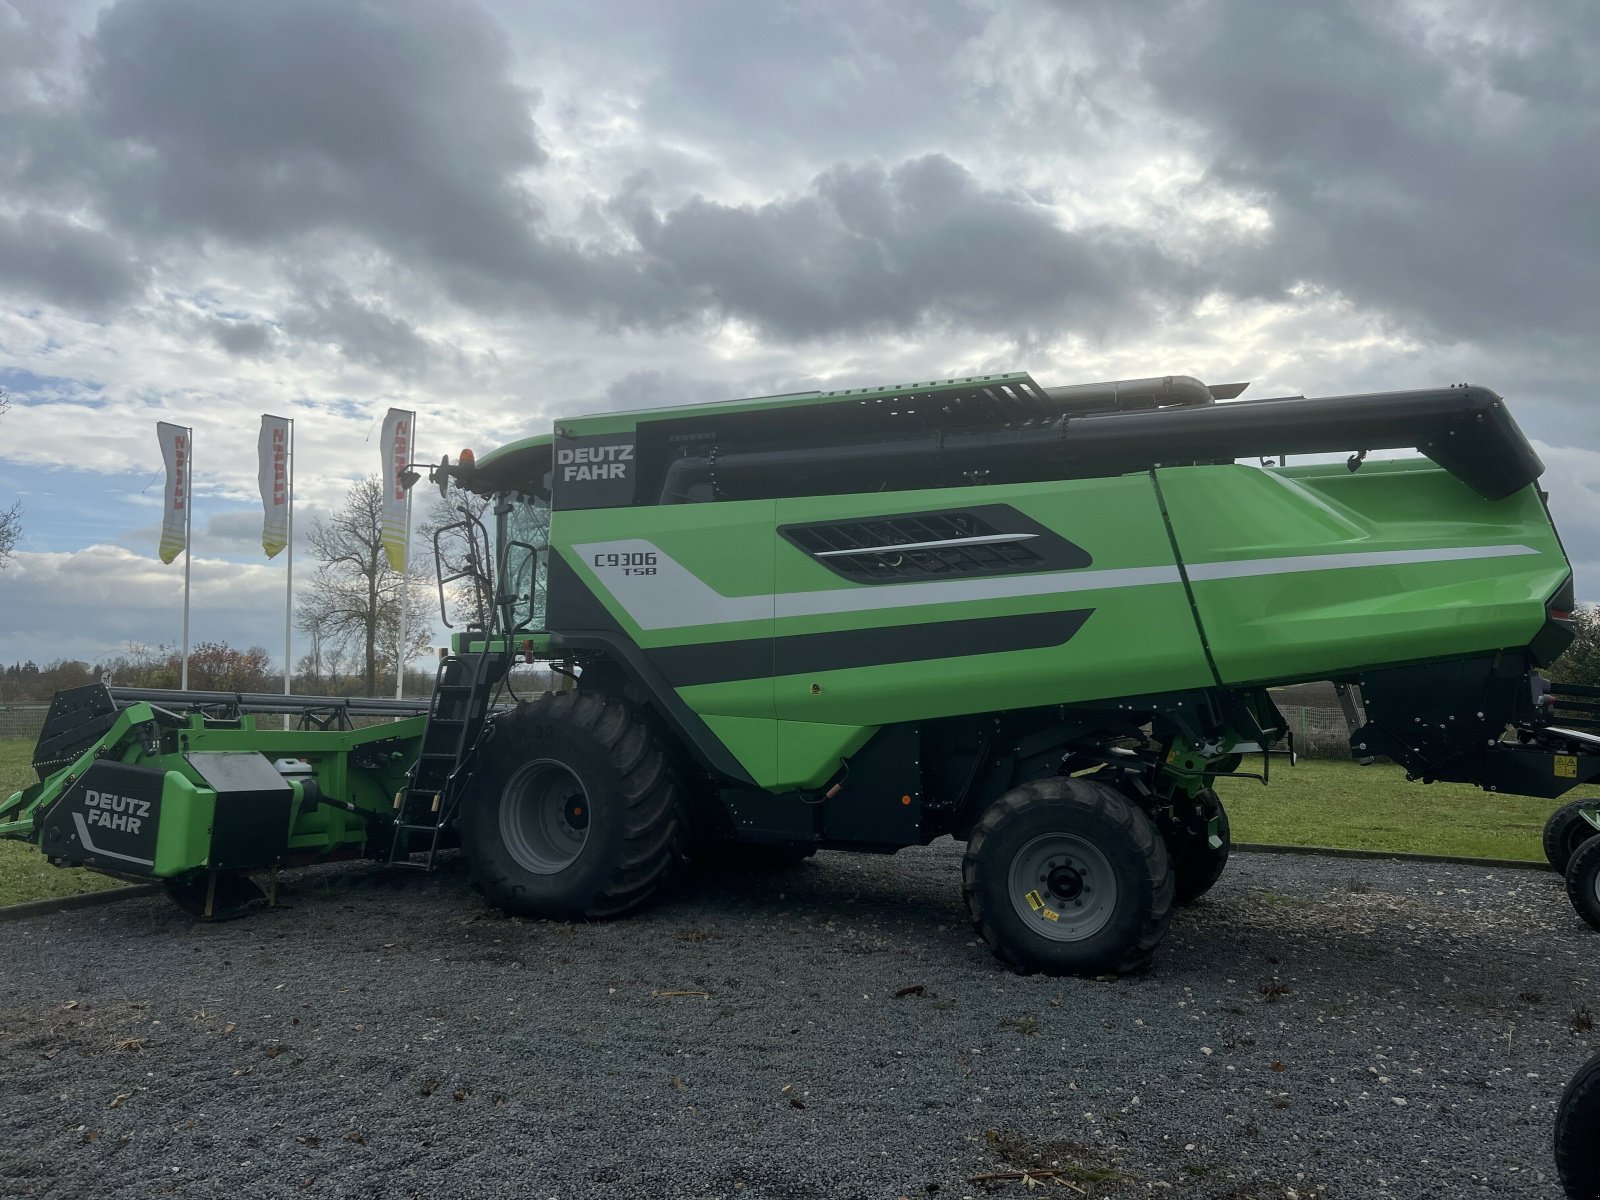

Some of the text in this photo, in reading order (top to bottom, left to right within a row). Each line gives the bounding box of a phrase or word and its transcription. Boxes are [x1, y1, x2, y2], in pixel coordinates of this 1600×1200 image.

[557, 444, 634, 465] DEUTZ
[564, 463, 626, 481] FAHR
[594, 552, 657, 567] C9306
[622, 567, 657, 576] TSB
[84, 789, 151, 818] DEUTZ
[87, 809, 142, 835] FAHR
